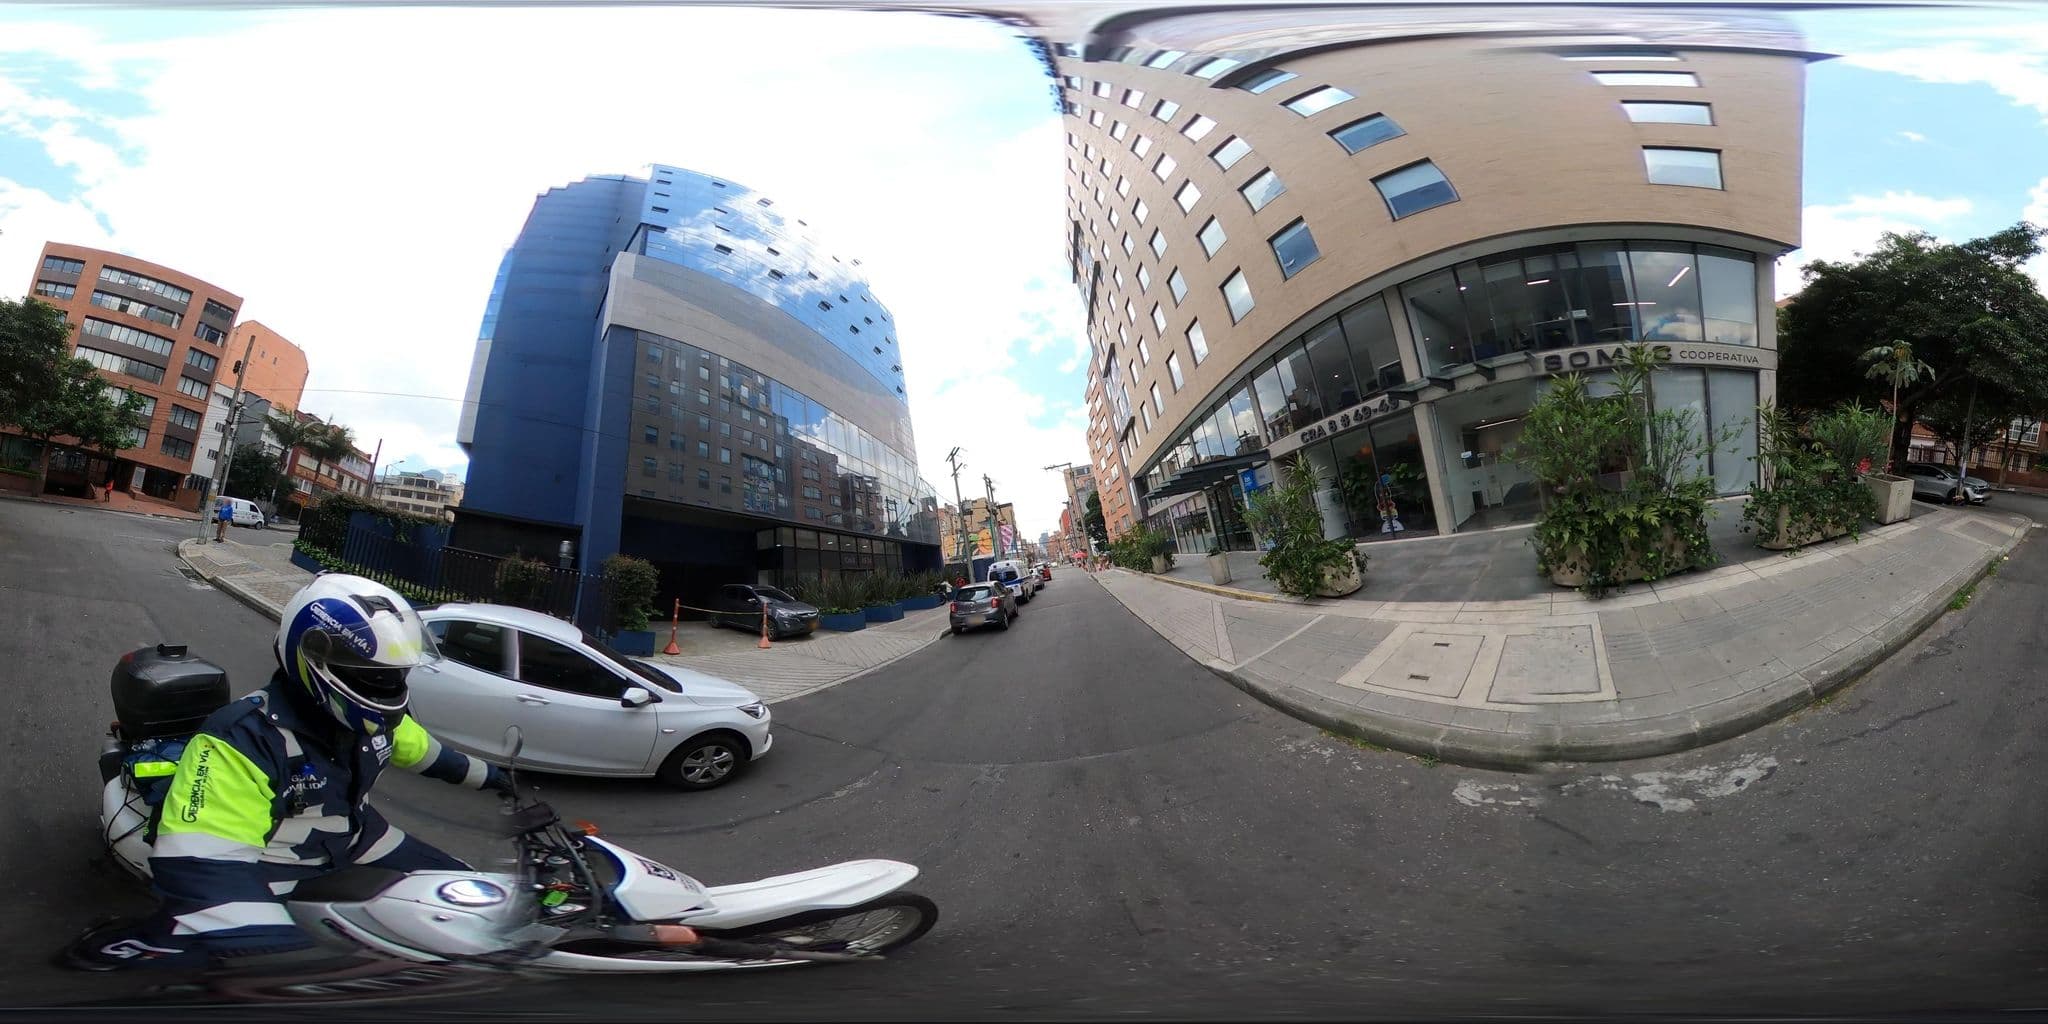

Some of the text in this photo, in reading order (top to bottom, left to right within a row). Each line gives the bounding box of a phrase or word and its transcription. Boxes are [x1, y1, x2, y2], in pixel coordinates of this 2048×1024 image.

[1543, 345, 1759, 372] SOMC COOPERATIVA
[1301, 425, 1327, 443] CRA
[341, 628, 355, 640] EN
[182, 779, 202, 823] GERENCIA
[196, 764, 206, 777] EN
